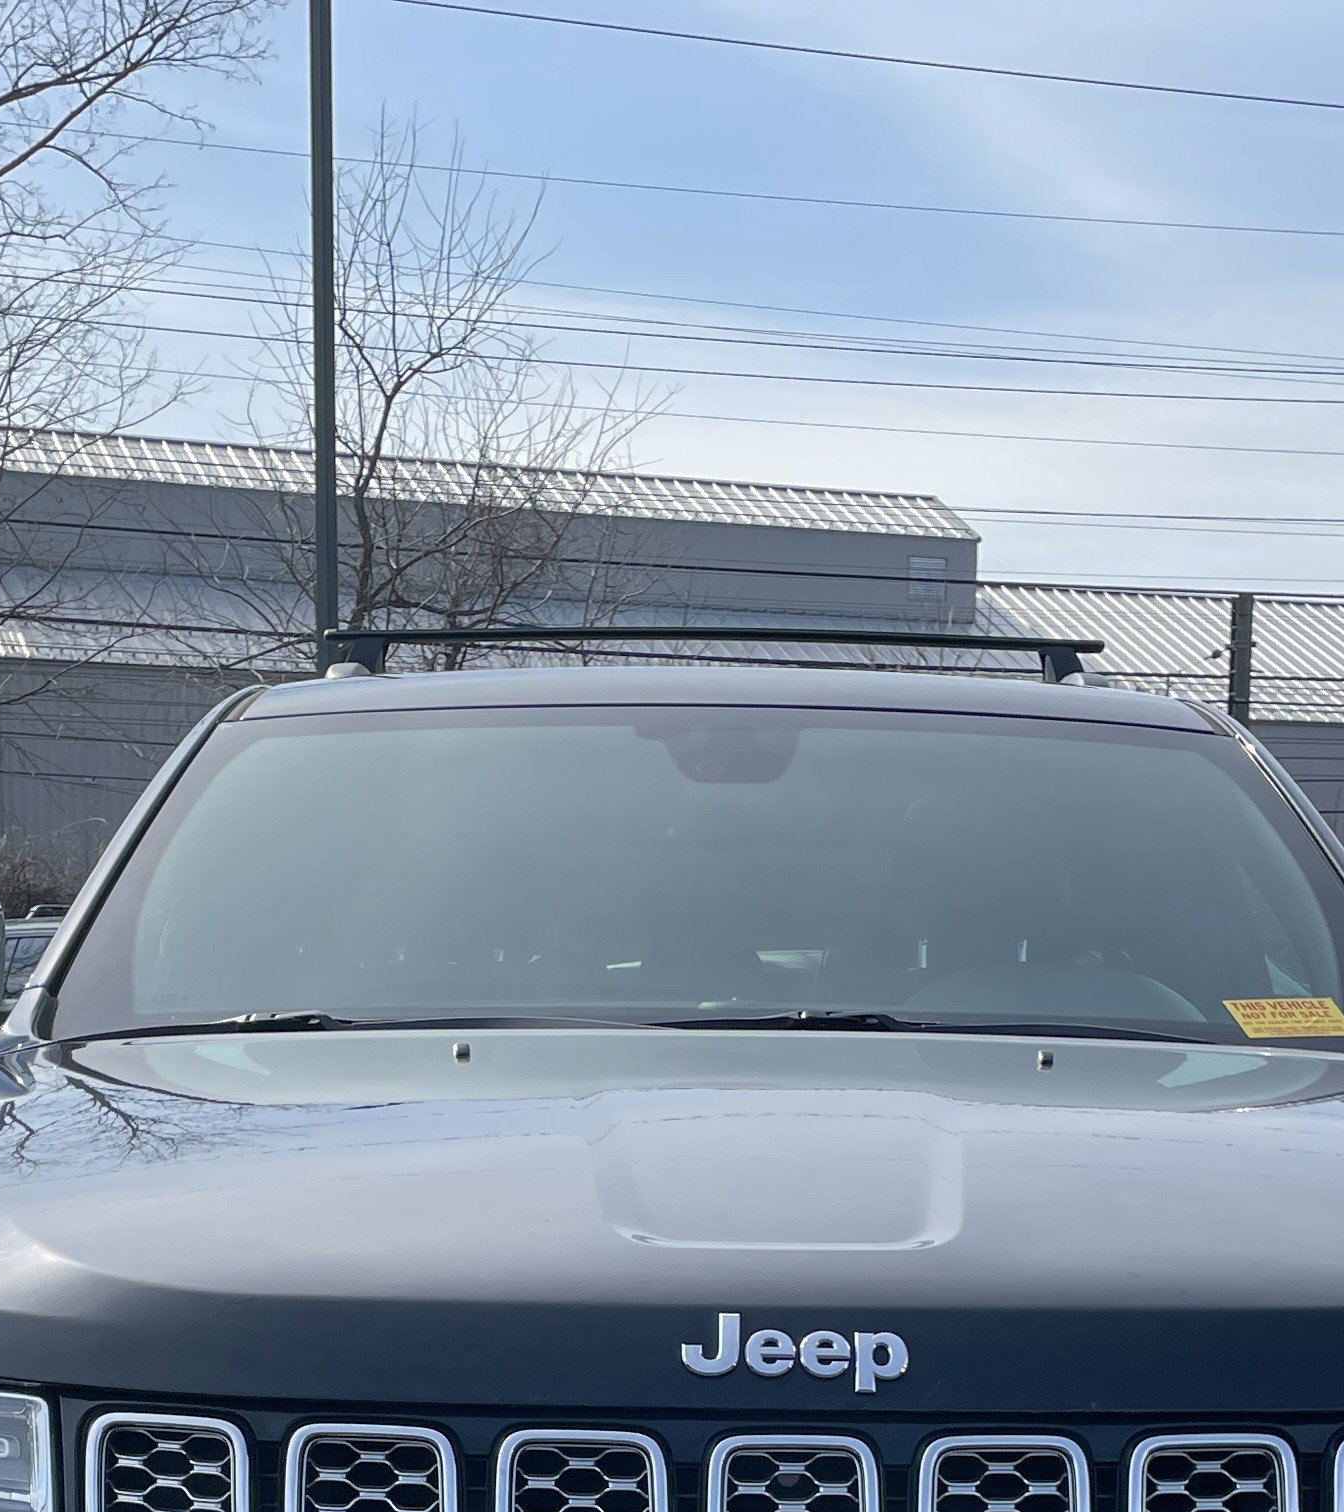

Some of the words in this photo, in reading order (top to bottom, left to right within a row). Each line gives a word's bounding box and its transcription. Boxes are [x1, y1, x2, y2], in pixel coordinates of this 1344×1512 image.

[1230, 1001, 1266, 1012] THIS
[1266, 1000, 1330, 1011] VEHICLE
[1241, 1012, 1267, 1020] NOT
[1271, 1011, 1297, 1019] FOR
[1299, 1010, 1334, 1019] SALE
[681, 1312, 909, 1394] Jeep
